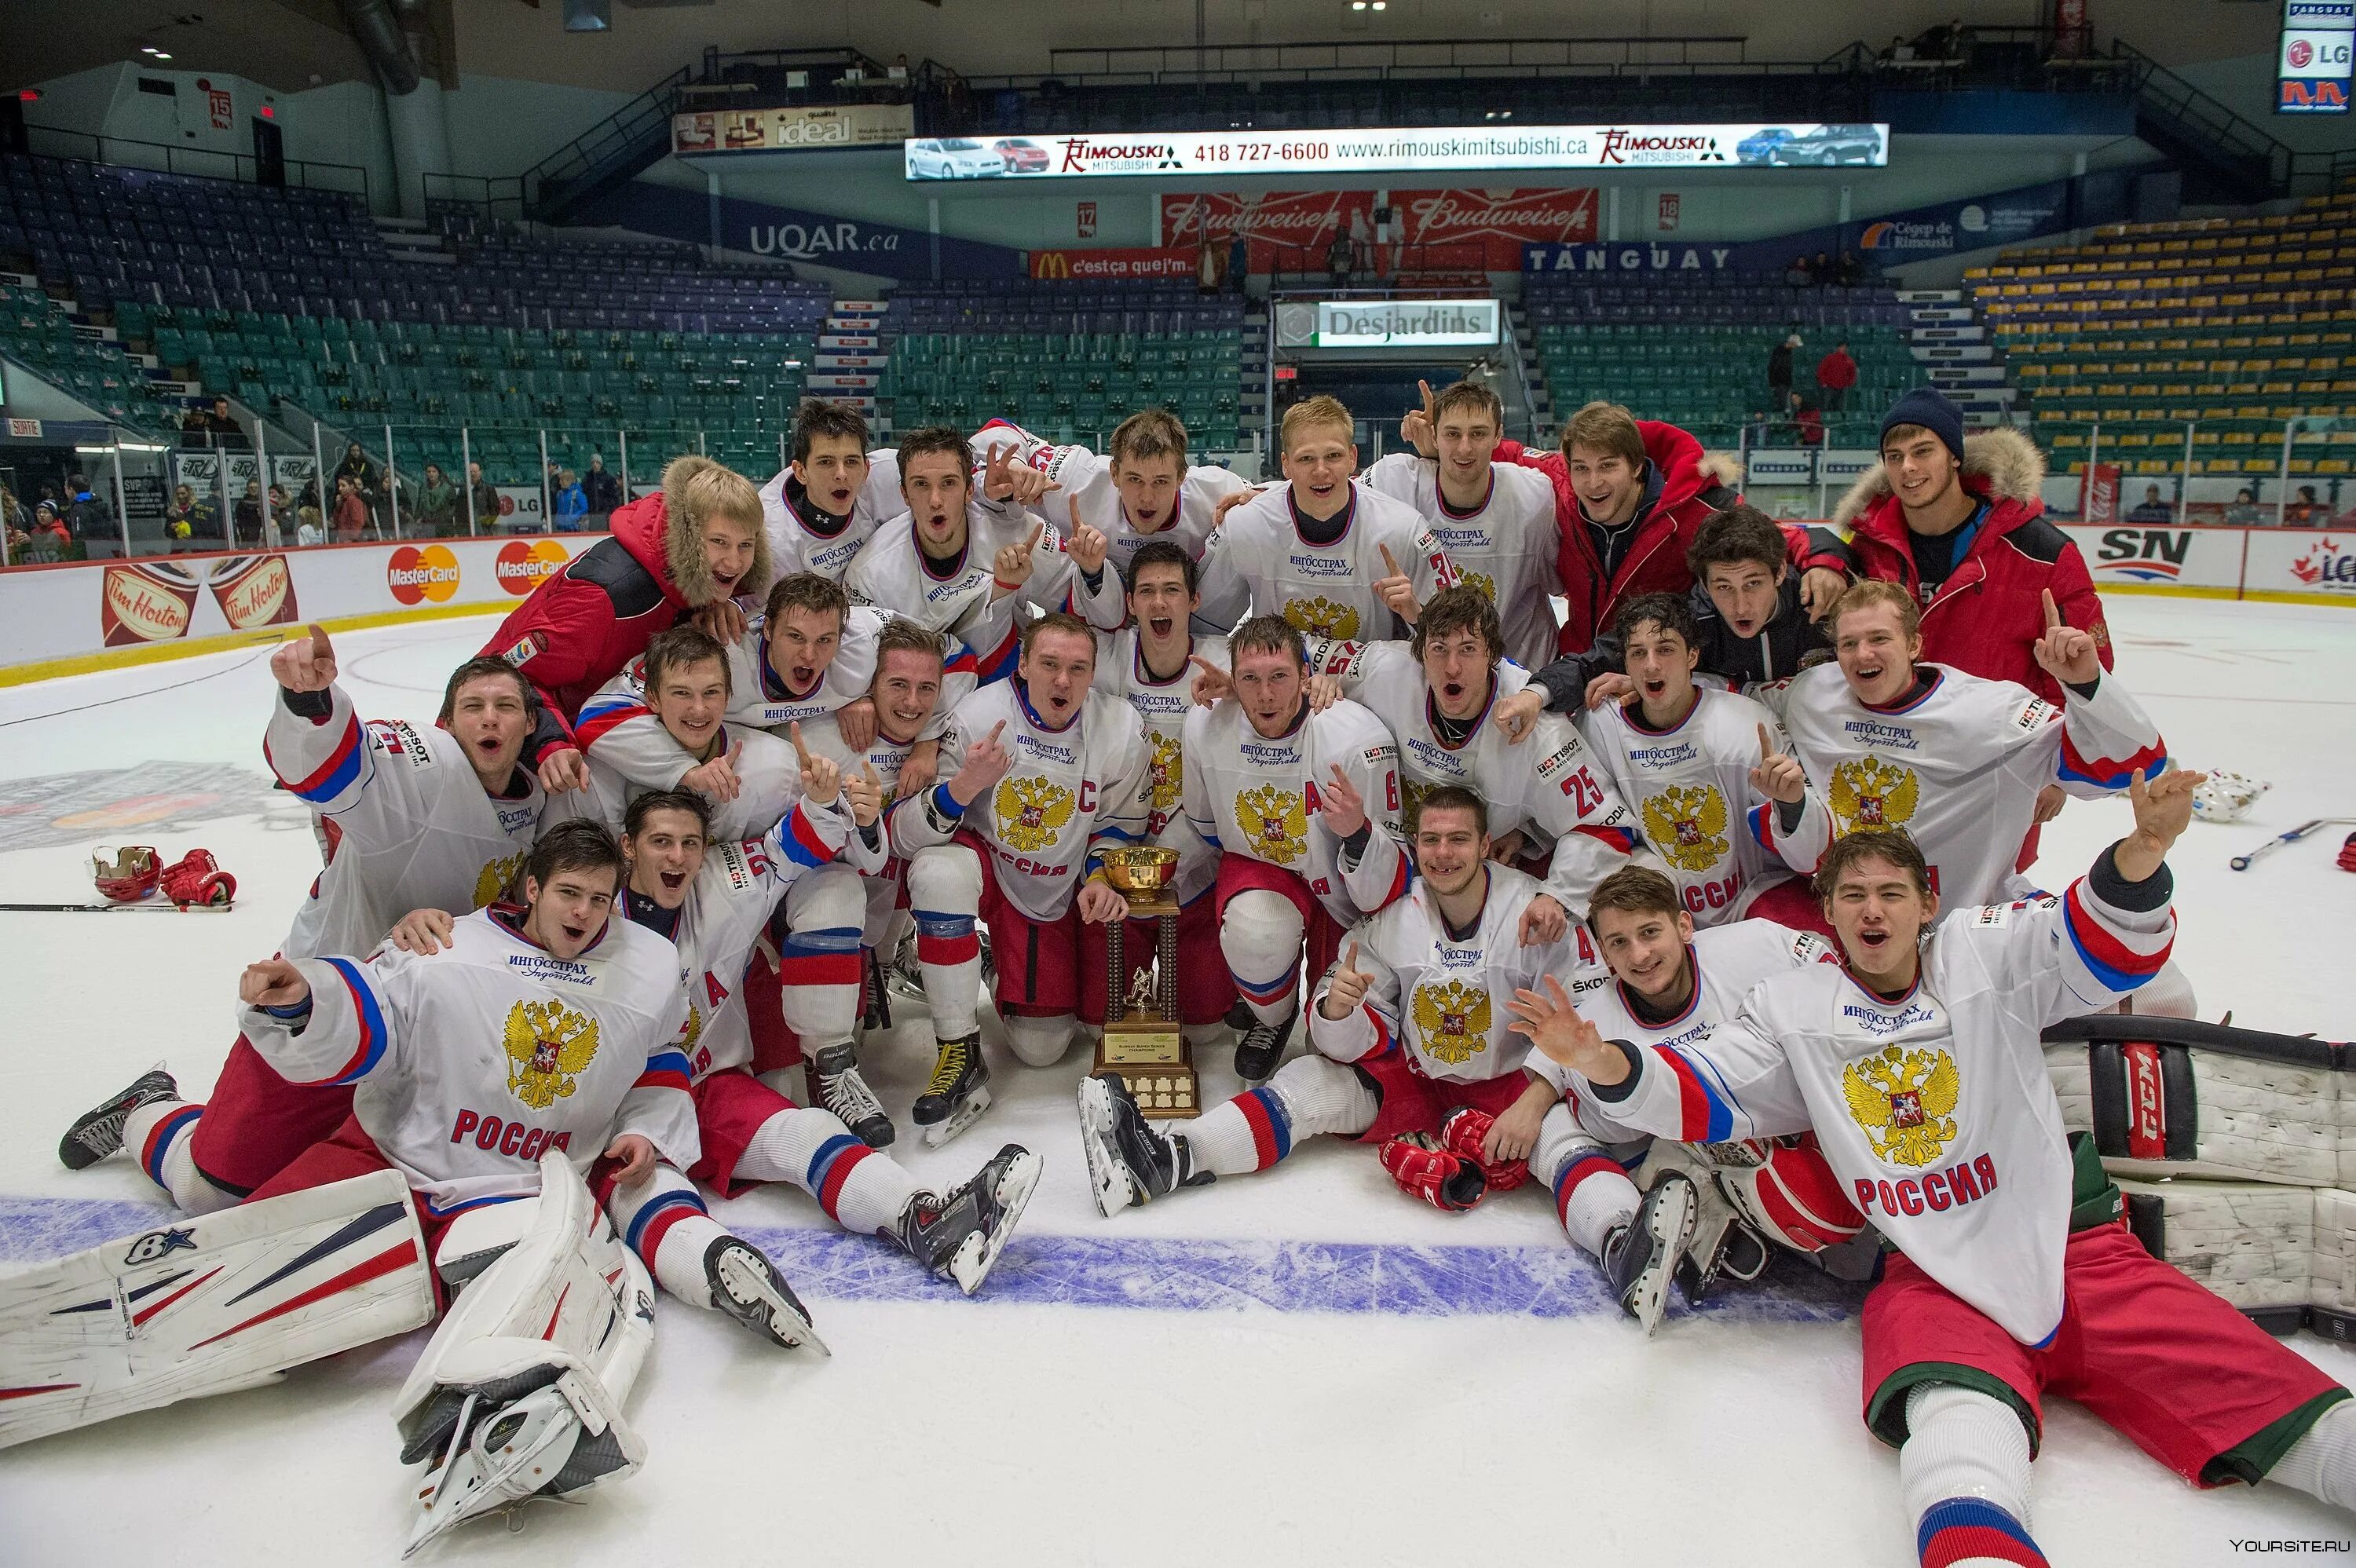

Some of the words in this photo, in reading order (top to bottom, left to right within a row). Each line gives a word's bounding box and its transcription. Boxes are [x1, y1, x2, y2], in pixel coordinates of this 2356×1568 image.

[2321, 46, 2350, 64] LG
[211, 98, 231, 115] 15
[777, 116, 851, 144] ideal
[1057, 137, 1164, 173] RIMOUSKI
[1194, 144, 1229, 162] 418
[1237, 142, 1329, 161] 727-6600
[1336, 135, 1587, 159] www.rimouskimitsubishi.ca
[1596, 129, 1706, 164] RIMOUSKI
[1631, 151, 1694, 163] MITSUBISHI
[1092, 160, 1152, 171] MITSUBISHI
[1079, 209, 1096, 225] 17
[1165, 199, 1340, 234] Budweiser
[1411, 196, 1588, 233] Budweiser
[751, 223, 899, 259] UQAR.ca
[1529, 249, 1729, 271] TANGUAY
[1330, 305, 1481, 343] Desjardins
[13, 420, 39, 435] SORTIE
[519, 499, 539, 512] LG
[1432, 528, 1484, 539] НГОССТРАХ
[2098, 529, 2192, 565] SN
[1290, 555, 1346, 568] ИНГОССТРАХ
[390, 565, 458, 587] MasterCard
[108, 572, 131, 611] Tim
[226, 598, 252, 622] Tim
[764, 706, 826, 719] ИНГОССТРАХ
[1844, 721, 1912, 740] ИНГОССТРАХ
[1017, 735, 1070, 756] ИНГОССТРАХ
[1240, 744, 1294, 757] ИНГОССТРАХ
[1407, 738, 1462, 768] ИНГОССТРАХ
[1551, 738, 1579, 762] TISSOT
[1630, 742, 1691, 760] ИНГОССТРАХ
[1078, 780, 1096, 813] C
[1560, 764, 1604, 819] 25
[1575, 926, 1596, 966] 4
[509, 955, 588, 975] ИНГОССТРАХ
[704, 970, 730, 1008] A
[1843, 1004, 1921, 1025] ИНГОССТРАХ
[2136, 1051, 2158, 1141] CCM
[1854, 1152, 1999, 1217] РОССИЯ
